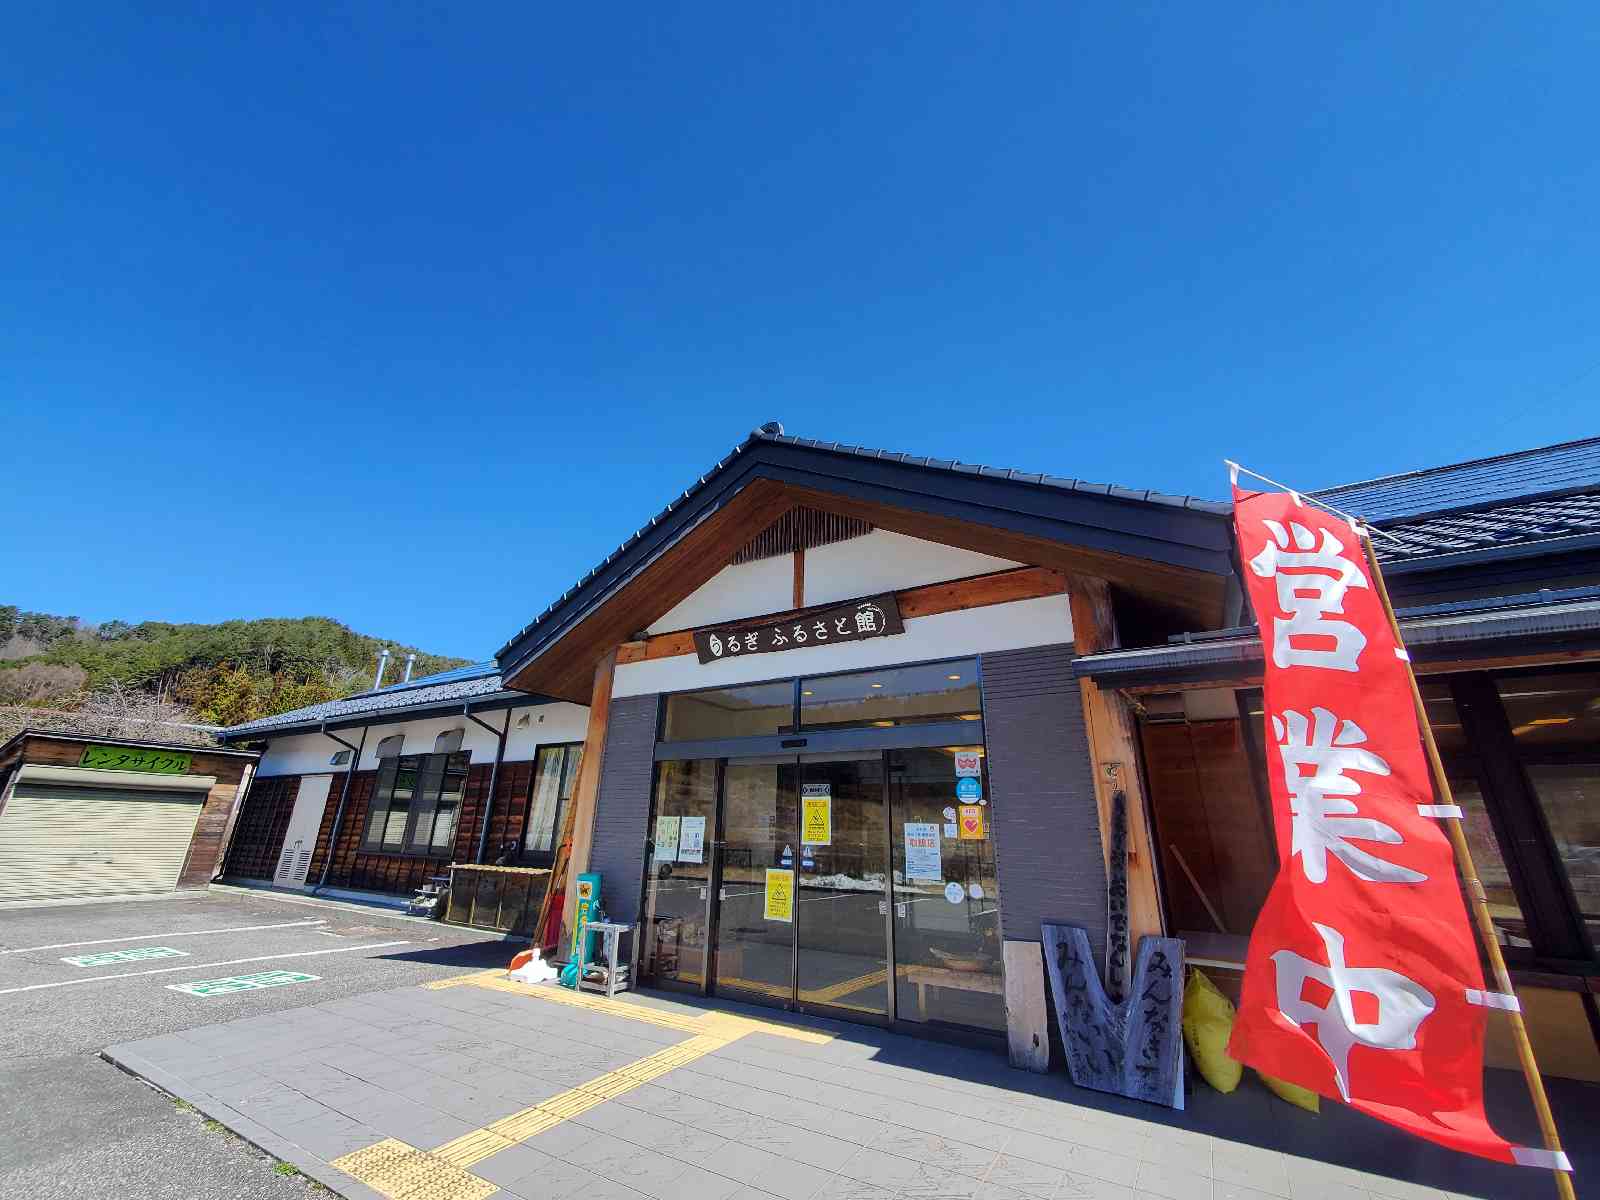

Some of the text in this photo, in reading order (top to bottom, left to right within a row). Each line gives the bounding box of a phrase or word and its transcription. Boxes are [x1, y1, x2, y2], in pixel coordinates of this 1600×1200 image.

[82, 750, 186, 771] レンタサイクル
[1250, 517, 1437, 1103] 営業中
